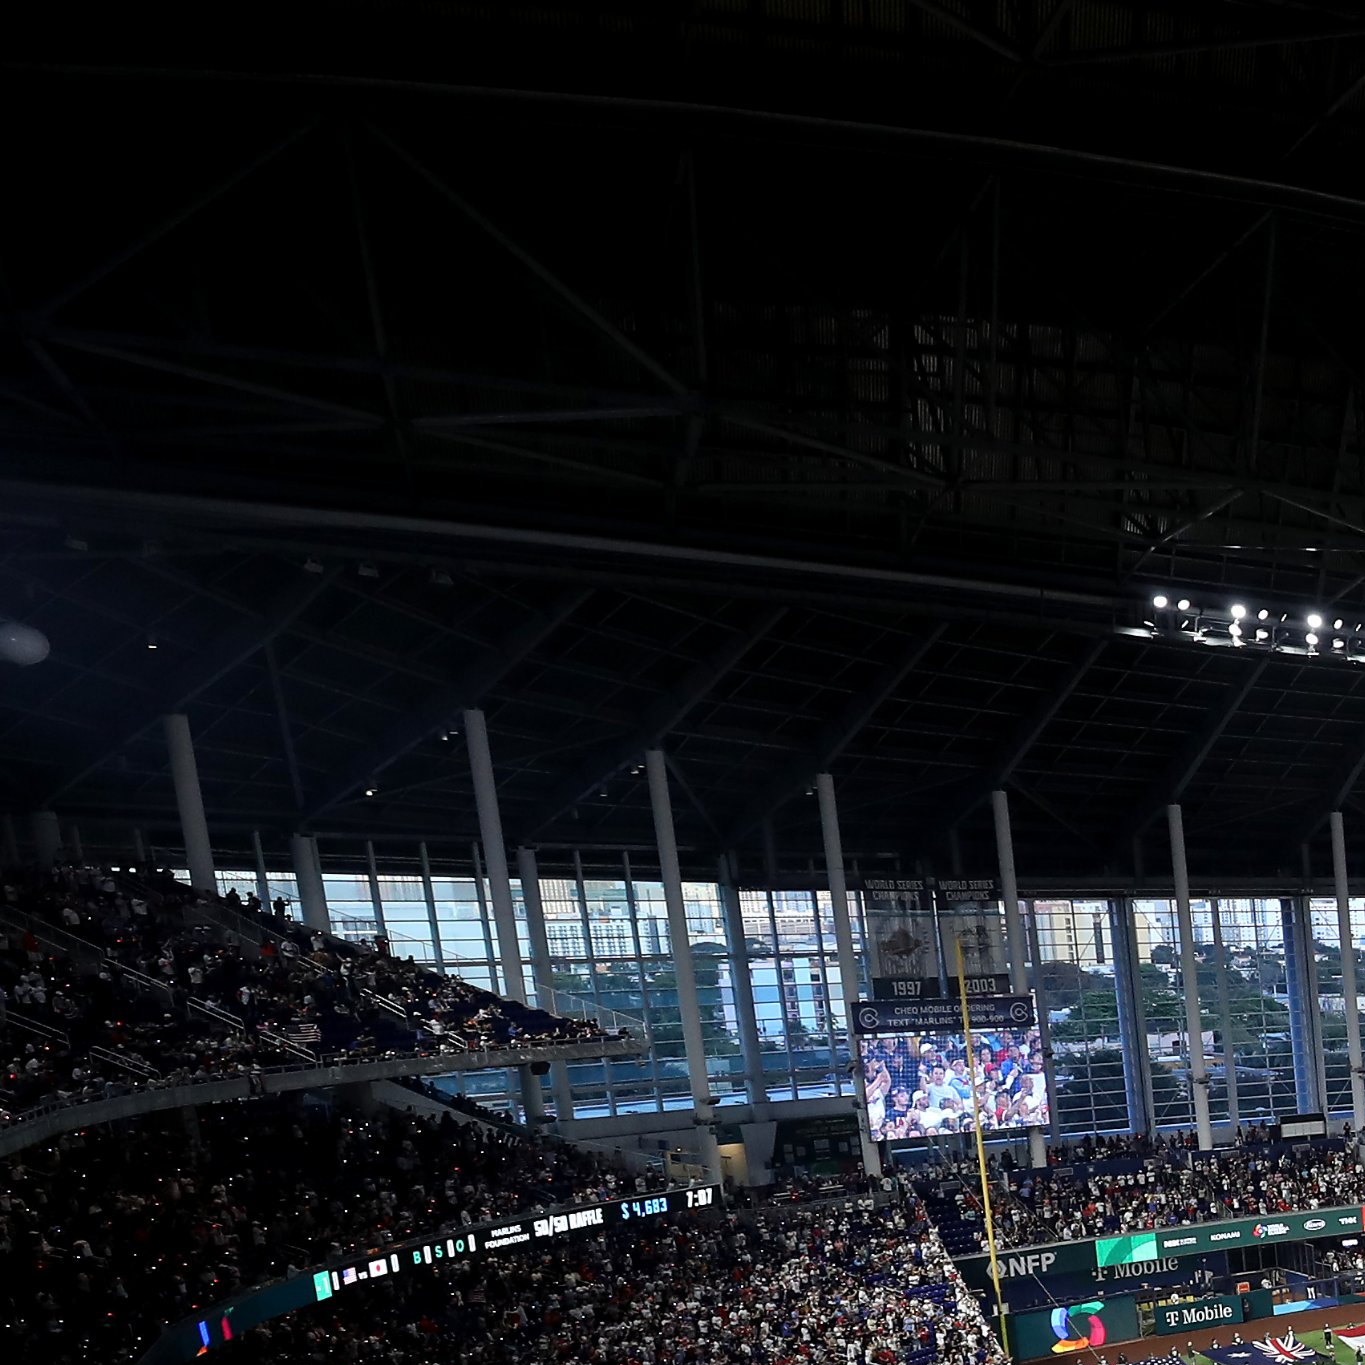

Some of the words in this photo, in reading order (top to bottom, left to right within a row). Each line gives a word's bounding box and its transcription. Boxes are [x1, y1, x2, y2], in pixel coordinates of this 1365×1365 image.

[864, 880, 894, 889] WORLD
[896, 880, 924, 890] SERIES
[938, 880, 967, 889] WORLD
[969, 880, 994, 889] SERIES
[891, 981, 922, 996] 1997
[965, 978, 996, 993] 2003
[919, 1005, 952, 1014] MOBILE
[887, 1018, 909, 1027] TEXT
[632, 1197, 668, 1217] 4,683
[484, 1233, 530, 1249] FOUNDATION
[1210, 1231, 1241, 1241] KONAMI
[413, 1250, 421, 1264] B
[434, 1245, 443, 1258] S
[1008, 1253, 1056, 1277] NFP
[1113, 1257, 1179, 1280] Mobile
[1182, 1303, 1233, 1325] Mobile
